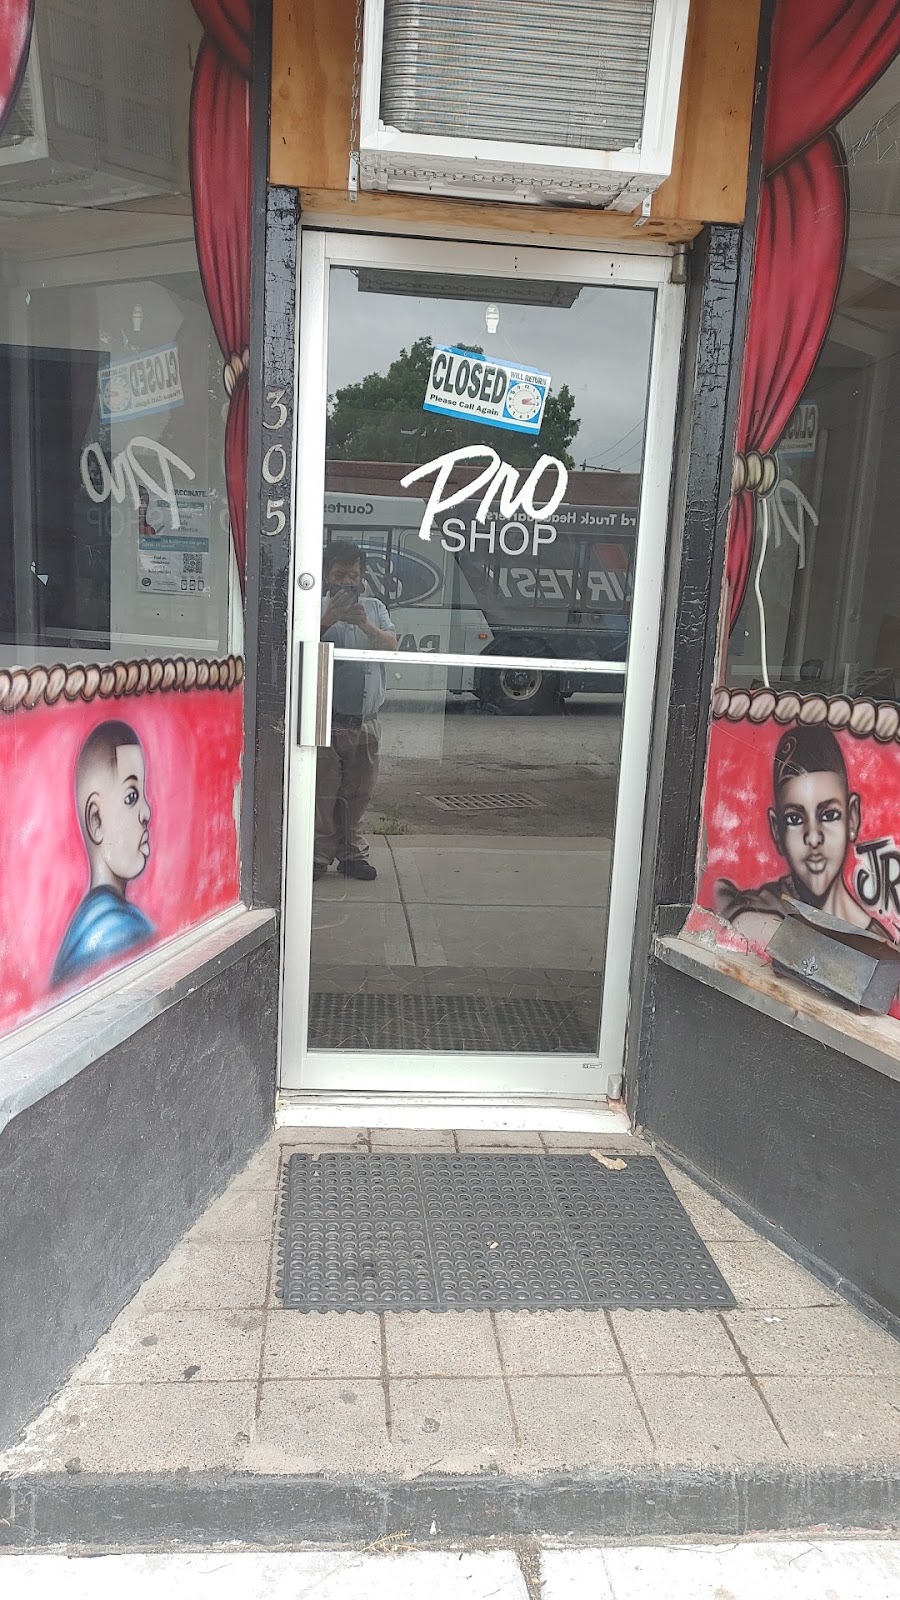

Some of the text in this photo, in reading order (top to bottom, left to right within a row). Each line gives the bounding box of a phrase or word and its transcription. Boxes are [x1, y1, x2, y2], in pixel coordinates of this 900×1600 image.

[432, 353, 508, 404] CLOSED
[510, 371, 524, 381] WILL
[430, 393, 457, 406] Please
[459, 401, 474, 410] Call
[476, 405, 499, 416] Again
[261, 388, 288, 537] 305
[400, 443, 568, 541] Pro
[440, 518, 557, 556] SHOP
